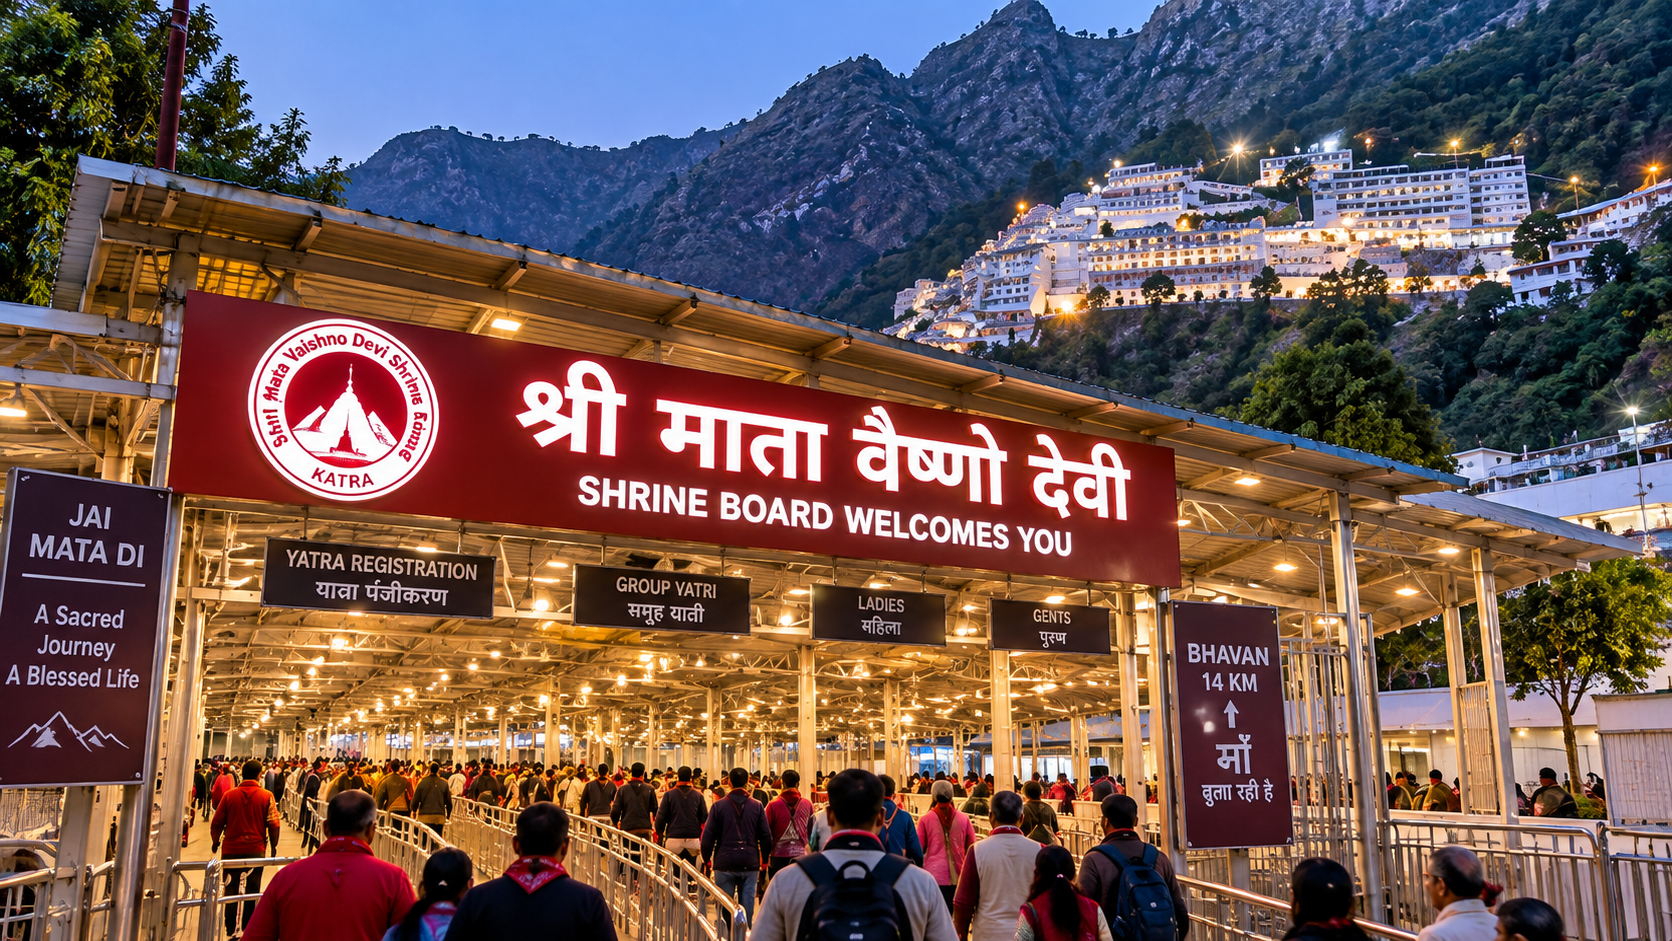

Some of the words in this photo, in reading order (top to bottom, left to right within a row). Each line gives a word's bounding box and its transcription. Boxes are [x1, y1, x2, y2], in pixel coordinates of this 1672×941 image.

[283, 334, 347, 361] Vaishno
[352, 333, 390, 358] Devi
[515, 360, 627, 457] श्री
[657, 399, 828, 481] माता
[853, 406, 1007, 505] वैष्णो
[1027, 433, 1132, 520] देवी
[311, 467, 374, 488] KATRA
[68, 503, 111, 529] JAI
[578, 476, 707, 517] SHRINE
[721, 492, 833, 529] BOARD
[844, 504, 1009, 550] WELCOMES
[1017, 526, 1071, 556] YOU
[29, 533, 107, 564] MATA
[116, 542, 144, 567] DI
[286, 549, 345, 571] YATRA
[351, 553, 477, 581] REGISTRATION
[617, 577, 670, 594] GROUP
[33, 603, 48, 624] A
[55, 605, 124, 628] Sacred
[859, 596, 904, 612] LADIES
[1034, 609, 1070, 624] GENTS
[37, 634, 115, 661] Journey
[1187, 642, 1270, 666] BHAVAN
[5, 664, 20, 684] A
[26, 664, 101, 687] Blessed
[106, 668, 139, 688] Life
[1202, 672, 1224, 691] 14
[1228, 672, 1258, 692] KM
[1235, 778, 1260, 802] रही
[1262, 778, 1274, 802] है
